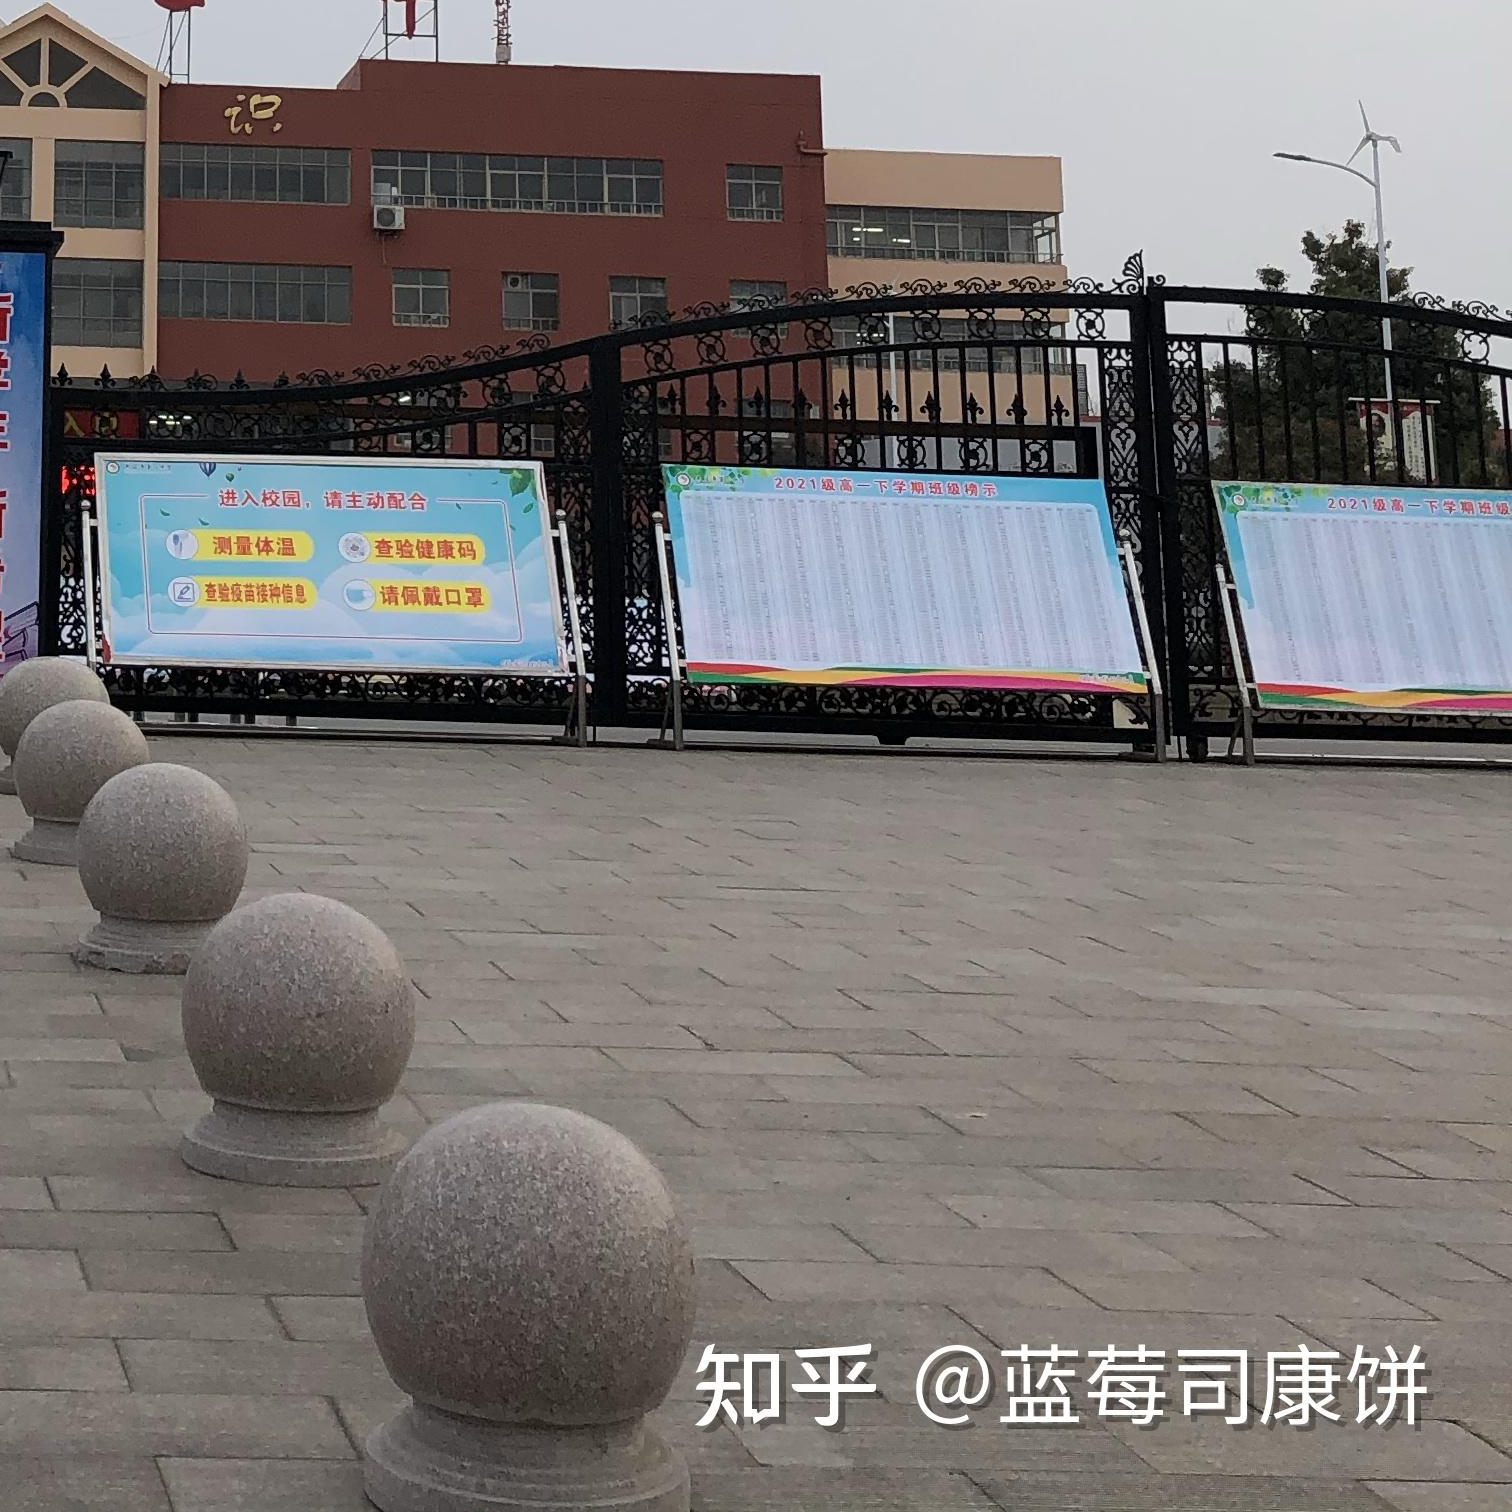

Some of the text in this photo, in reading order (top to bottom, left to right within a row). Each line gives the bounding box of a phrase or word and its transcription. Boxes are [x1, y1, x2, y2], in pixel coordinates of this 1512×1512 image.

[219, 488, 428, 511] 进入校园，请主动配合
[212, 536, 478, 561] 测量体温 查验健康码
[204, 582, 485, 608] 查验疫苗接种信息 请佩戴口罩
